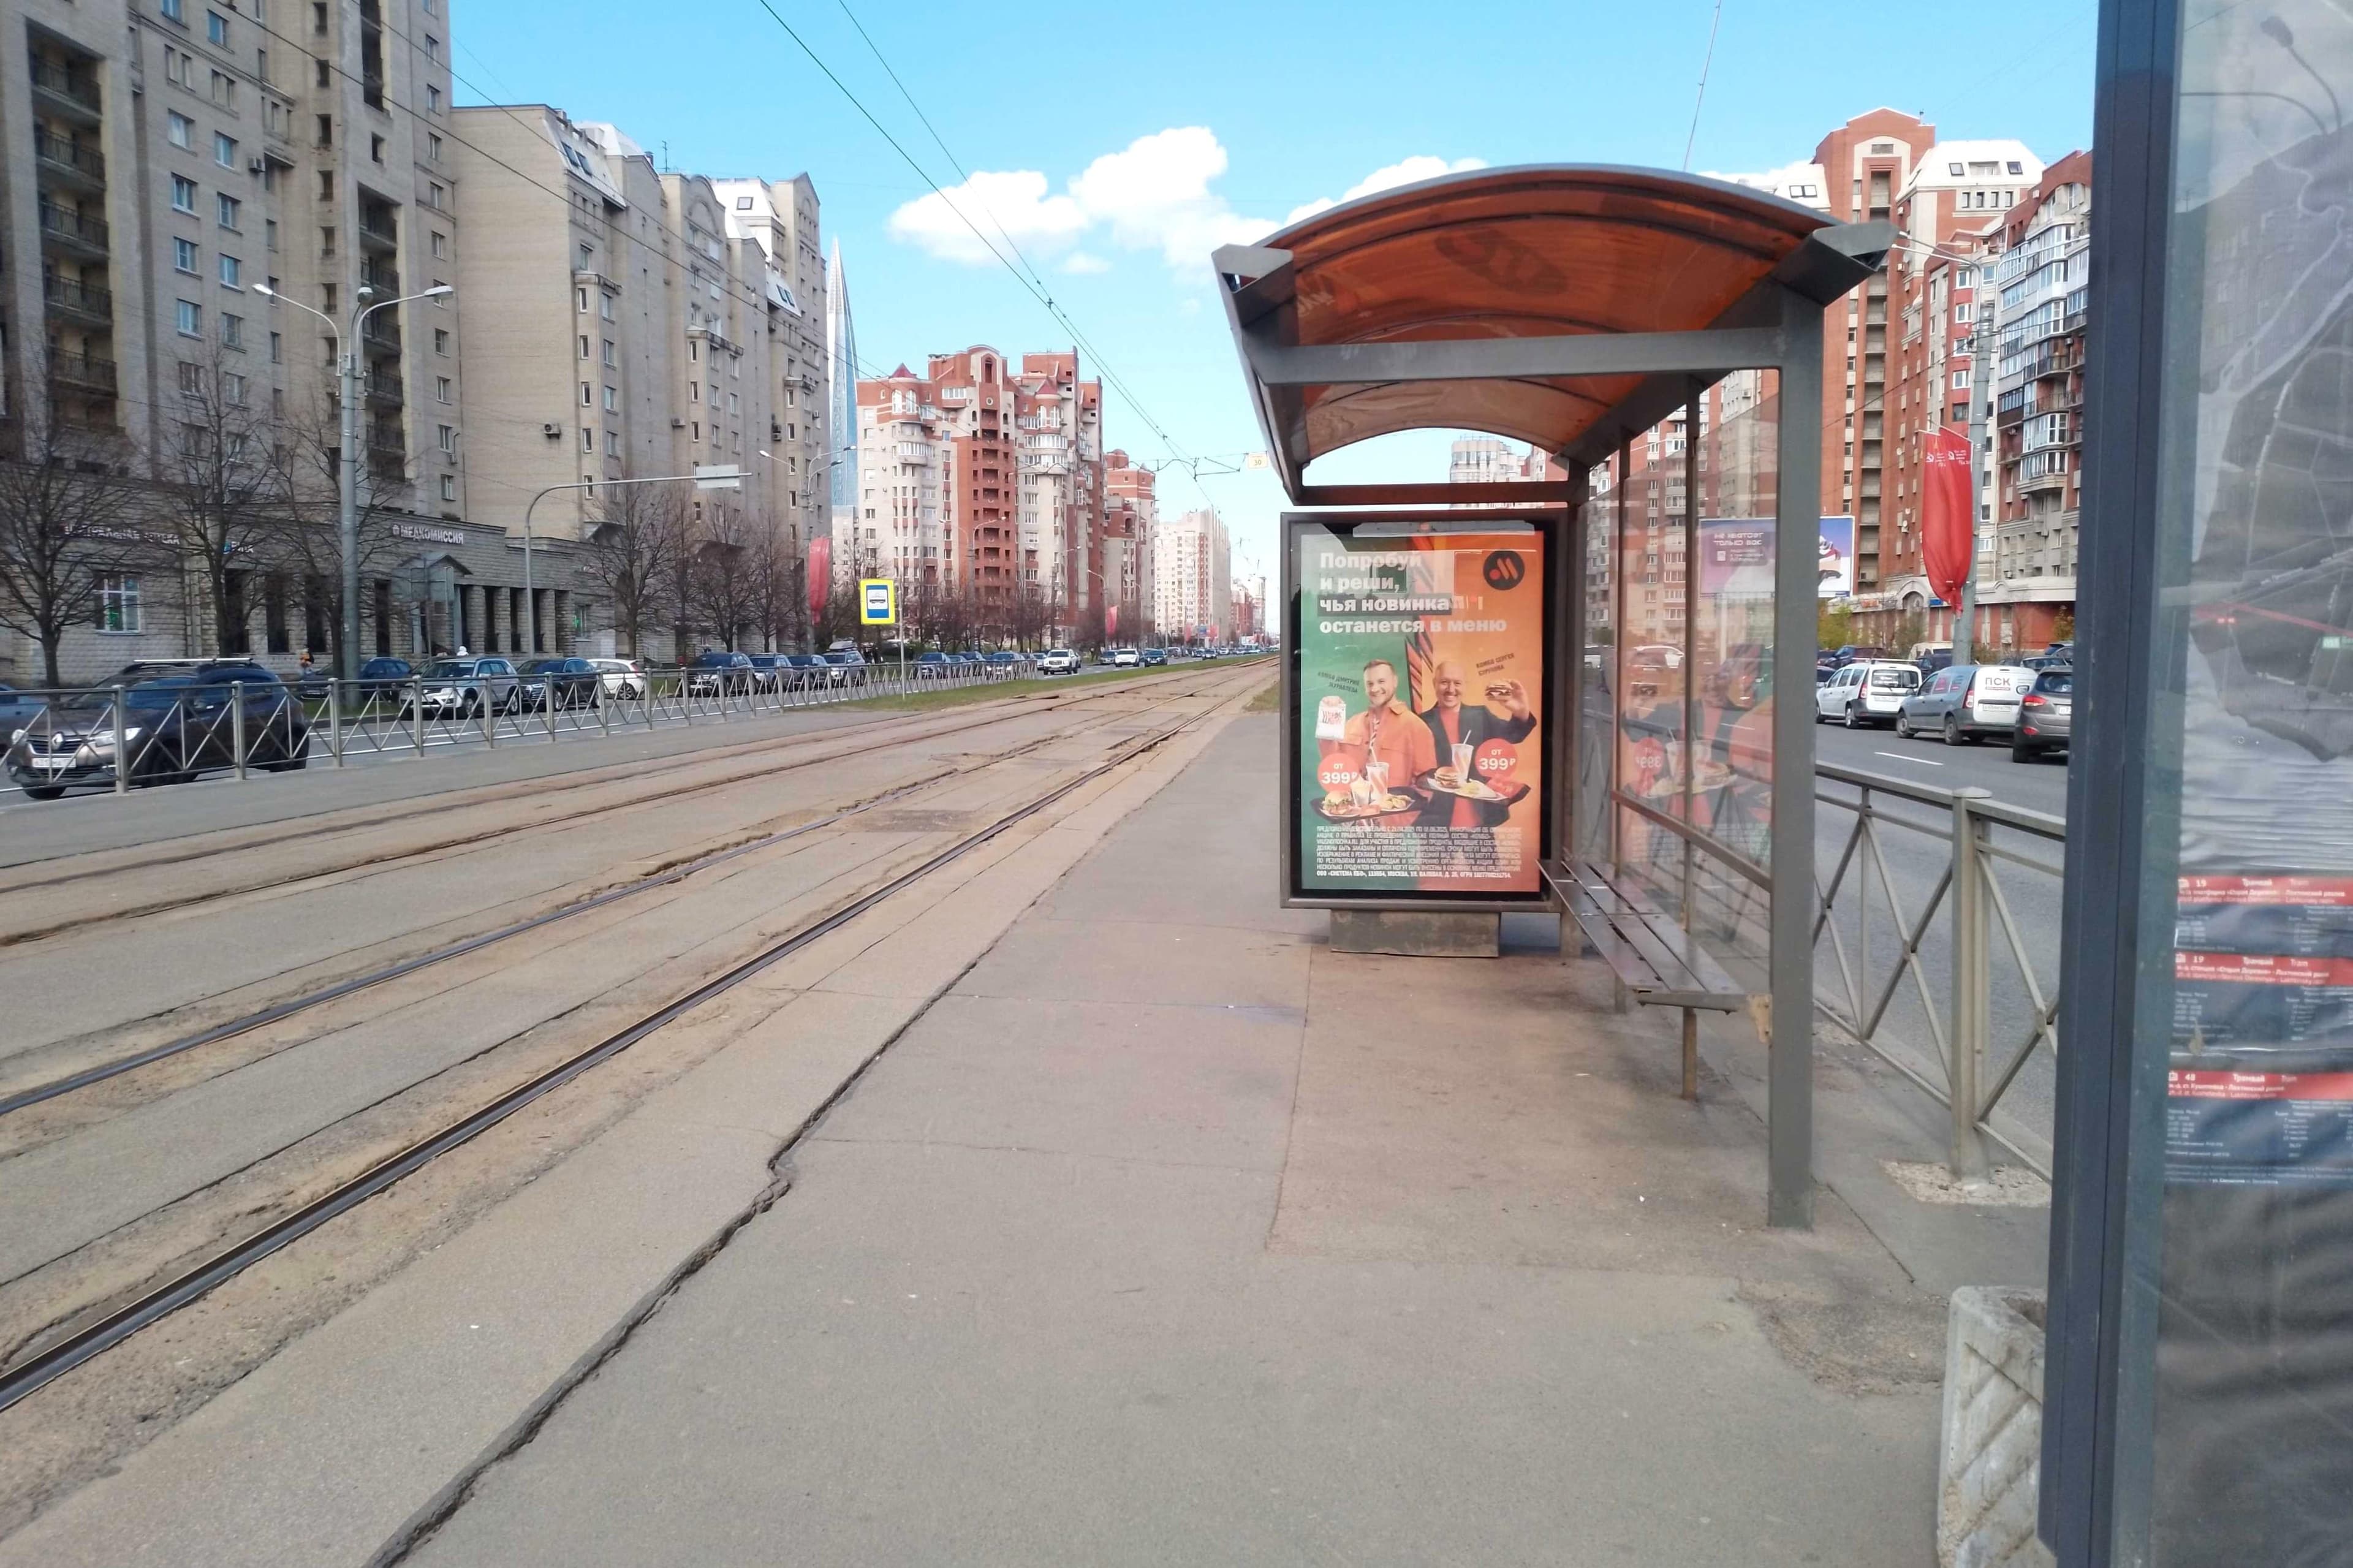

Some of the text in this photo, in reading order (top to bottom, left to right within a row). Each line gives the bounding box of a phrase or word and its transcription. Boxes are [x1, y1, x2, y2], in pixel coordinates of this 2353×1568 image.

[401, 525, 464, 544] МЕДКОМИССИЯ
[1320, 551, 1422, 570] Попробуй
[1320, 577, 1400, 593] и реши,
[1319, 599, 1356, 612] чья
[1362, 598, 1450, 611] новинка
[1319, 619, 1507, 633] останется в меню
[1985, 677, 2010, 686] ПСК
[2232, 1073, 2265, 1083] Трамвай
